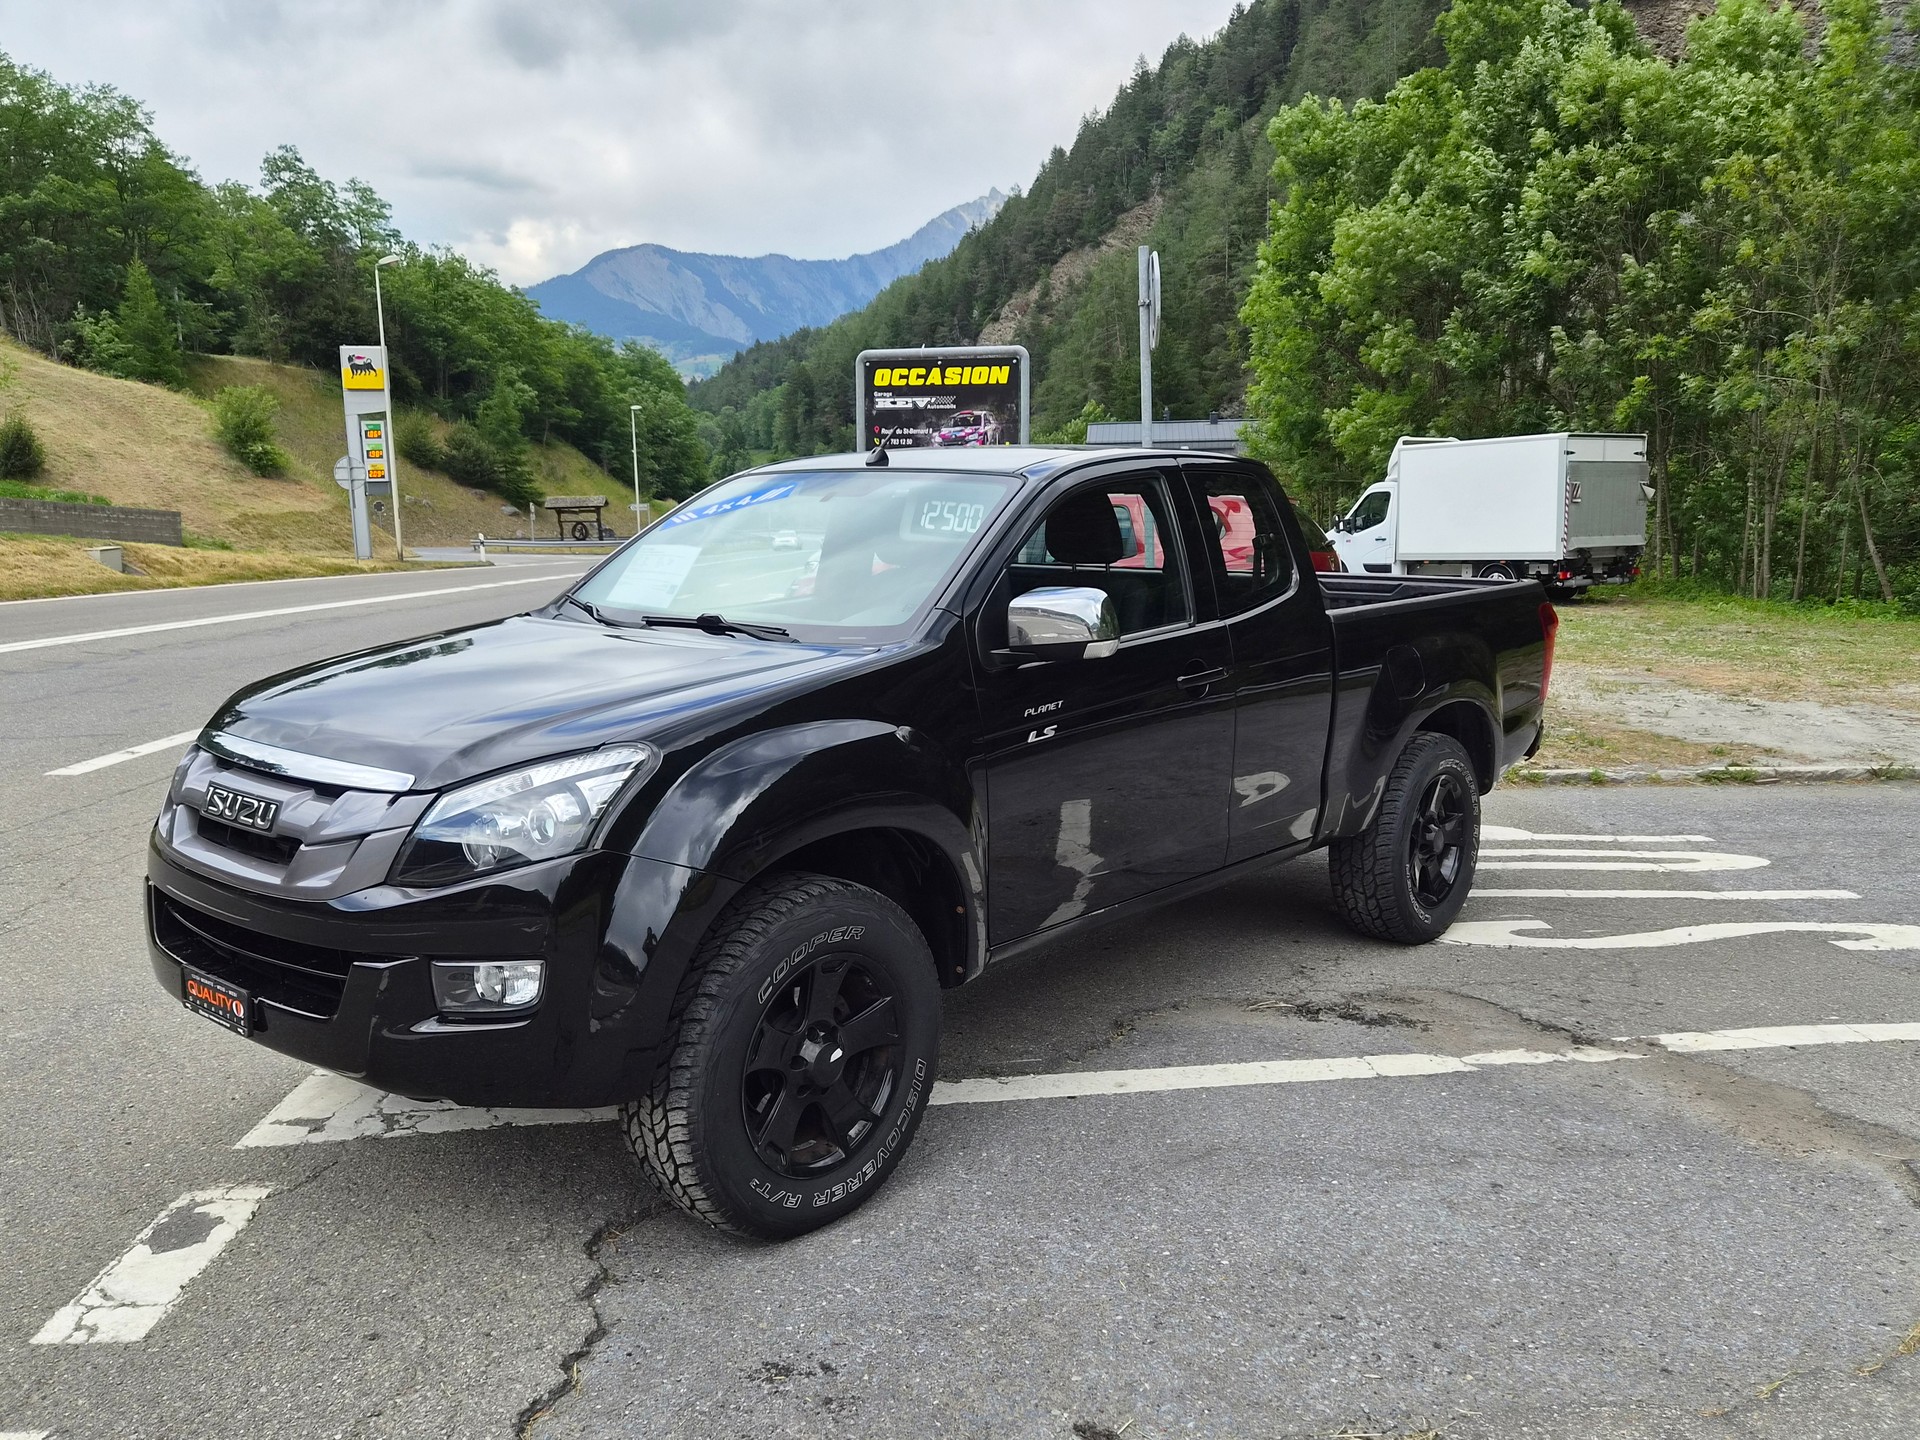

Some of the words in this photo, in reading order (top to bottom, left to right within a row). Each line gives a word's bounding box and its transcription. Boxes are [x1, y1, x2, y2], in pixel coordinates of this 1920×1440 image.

[873, 366, 1010, 386] OCCASION
[1024, 700, 1064, 717] PLANET
[1027, 724, 1058, 743] LS
[203, 786, 277, 830] ISUZU
[758, 925, 866, 1004] COOPER
[812, 1058, 927, 1208] DISCOVERER
